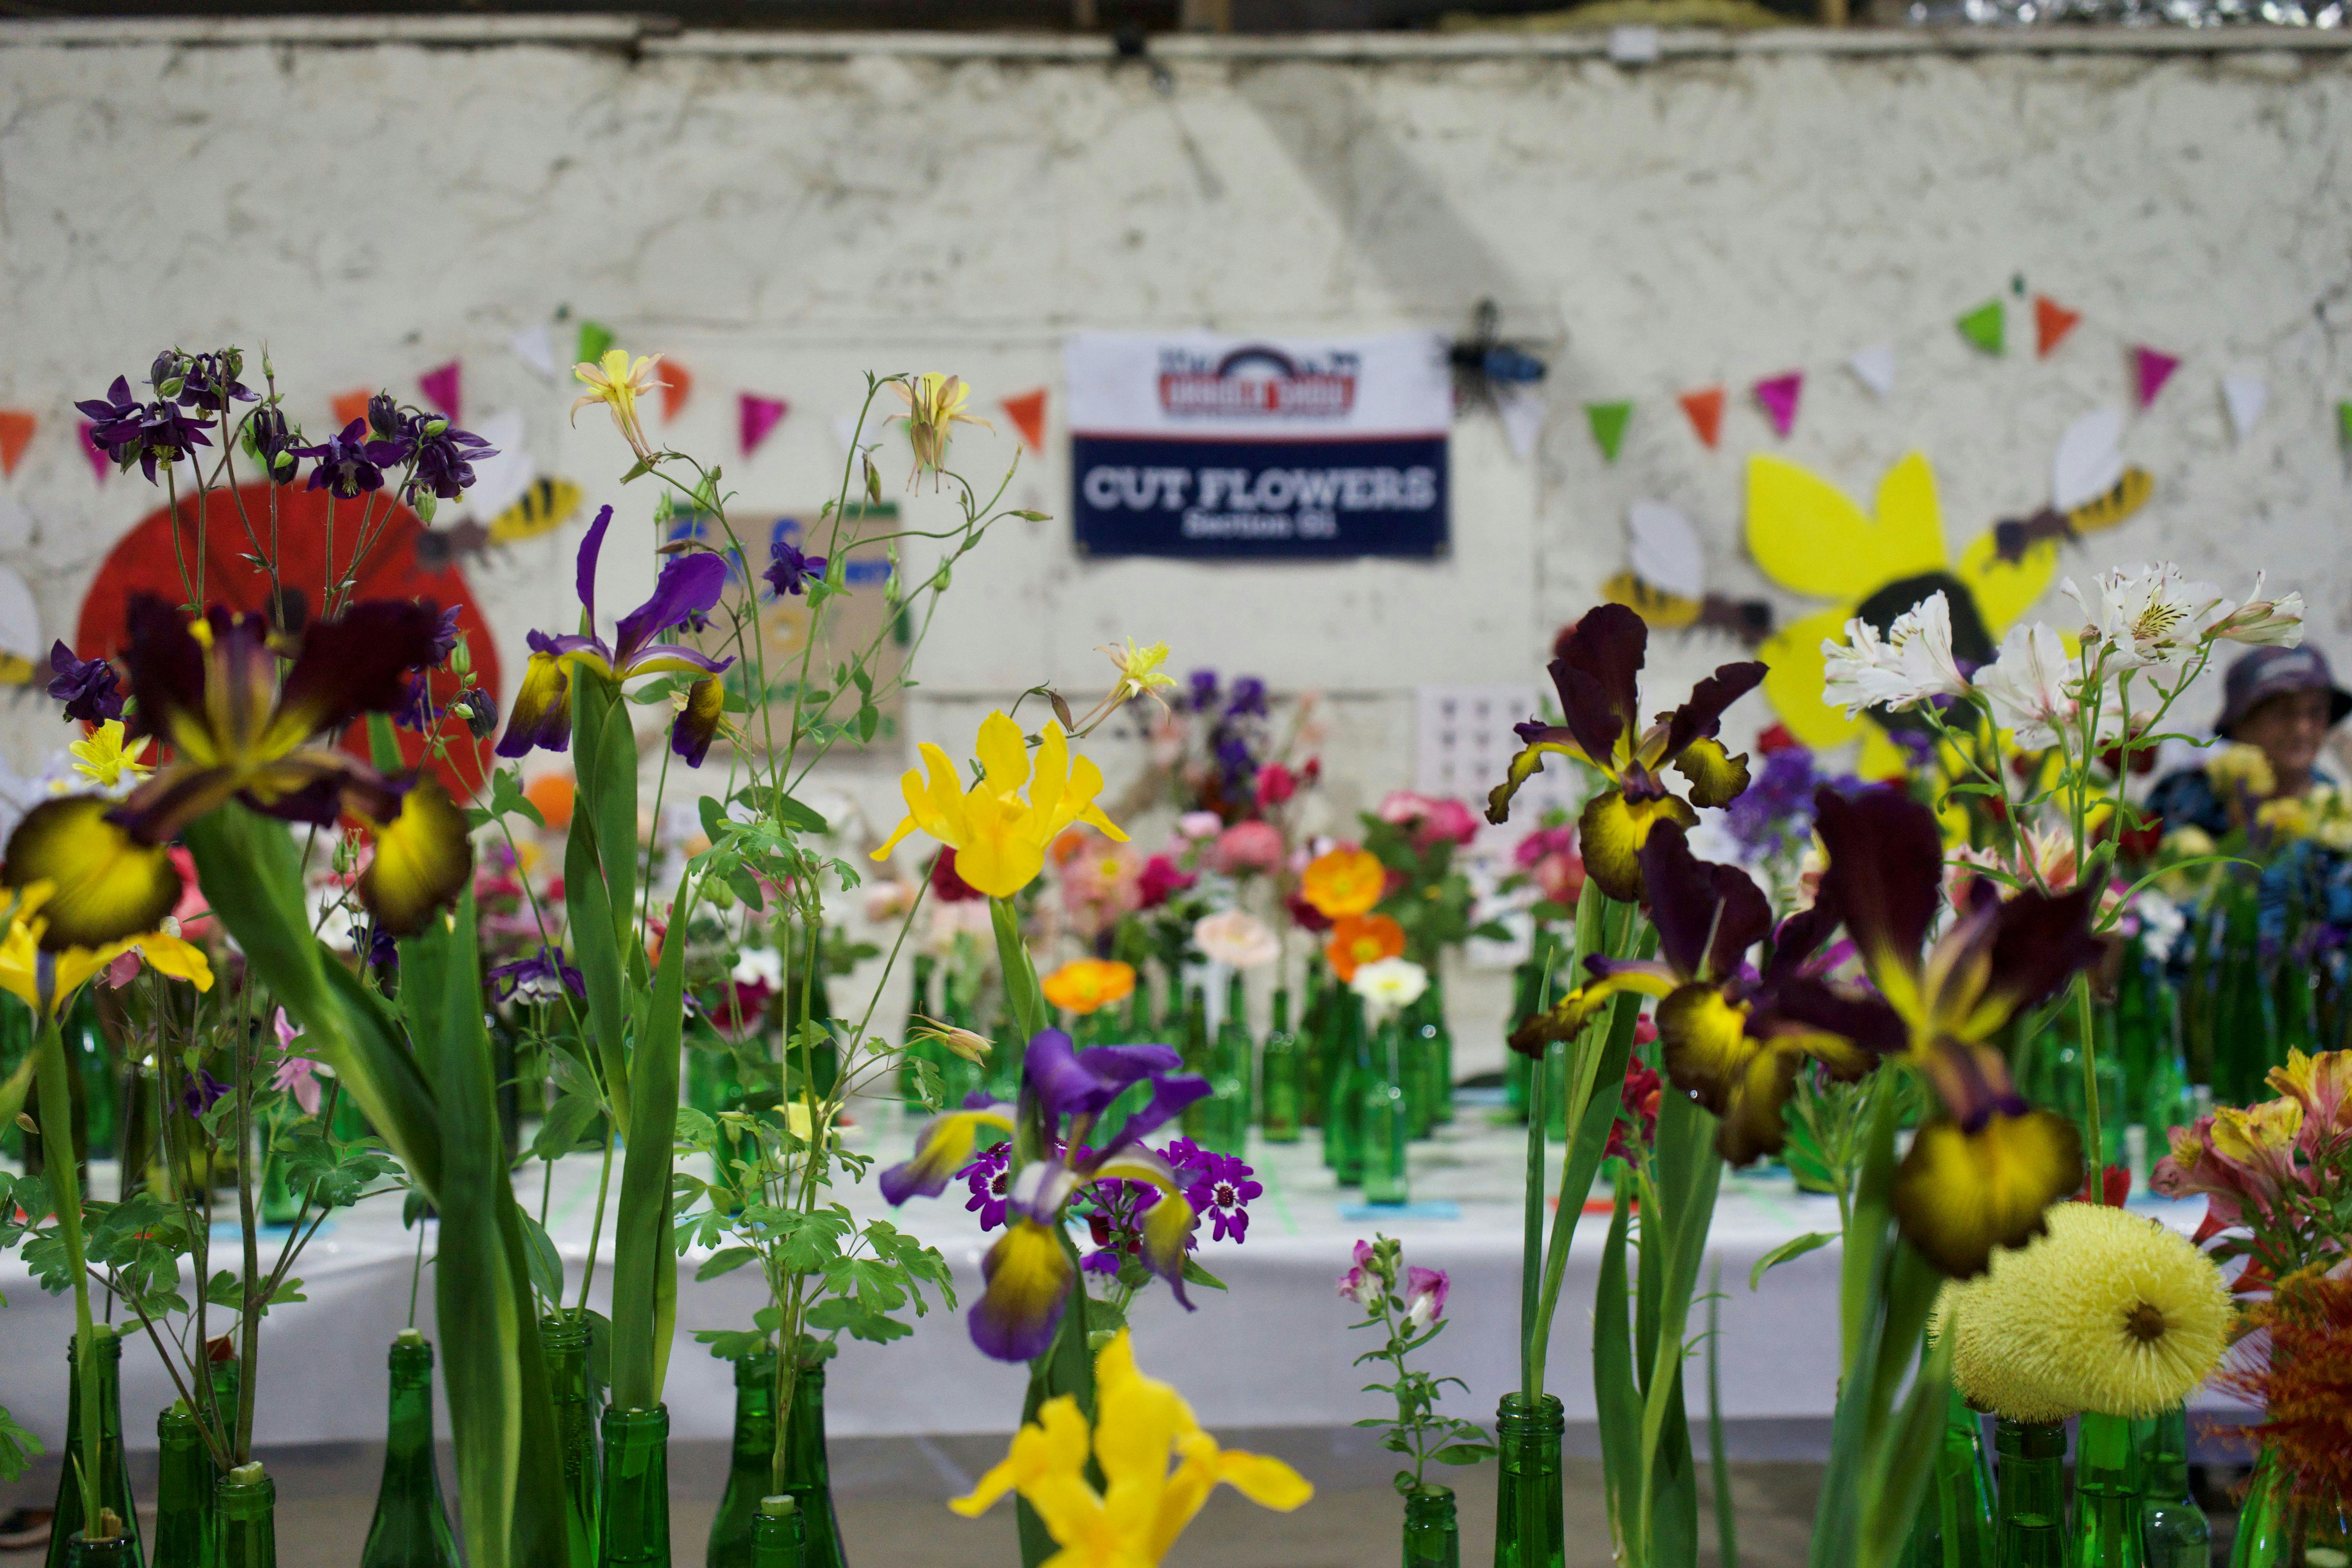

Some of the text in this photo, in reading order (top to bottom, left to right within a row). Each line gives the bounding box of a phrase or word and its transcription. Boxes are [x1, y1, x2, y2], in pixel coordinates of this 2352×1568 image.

[1085, 467, 1436, 510] CUT FLOWERS
[1184, 510, 1291, 537] Section
